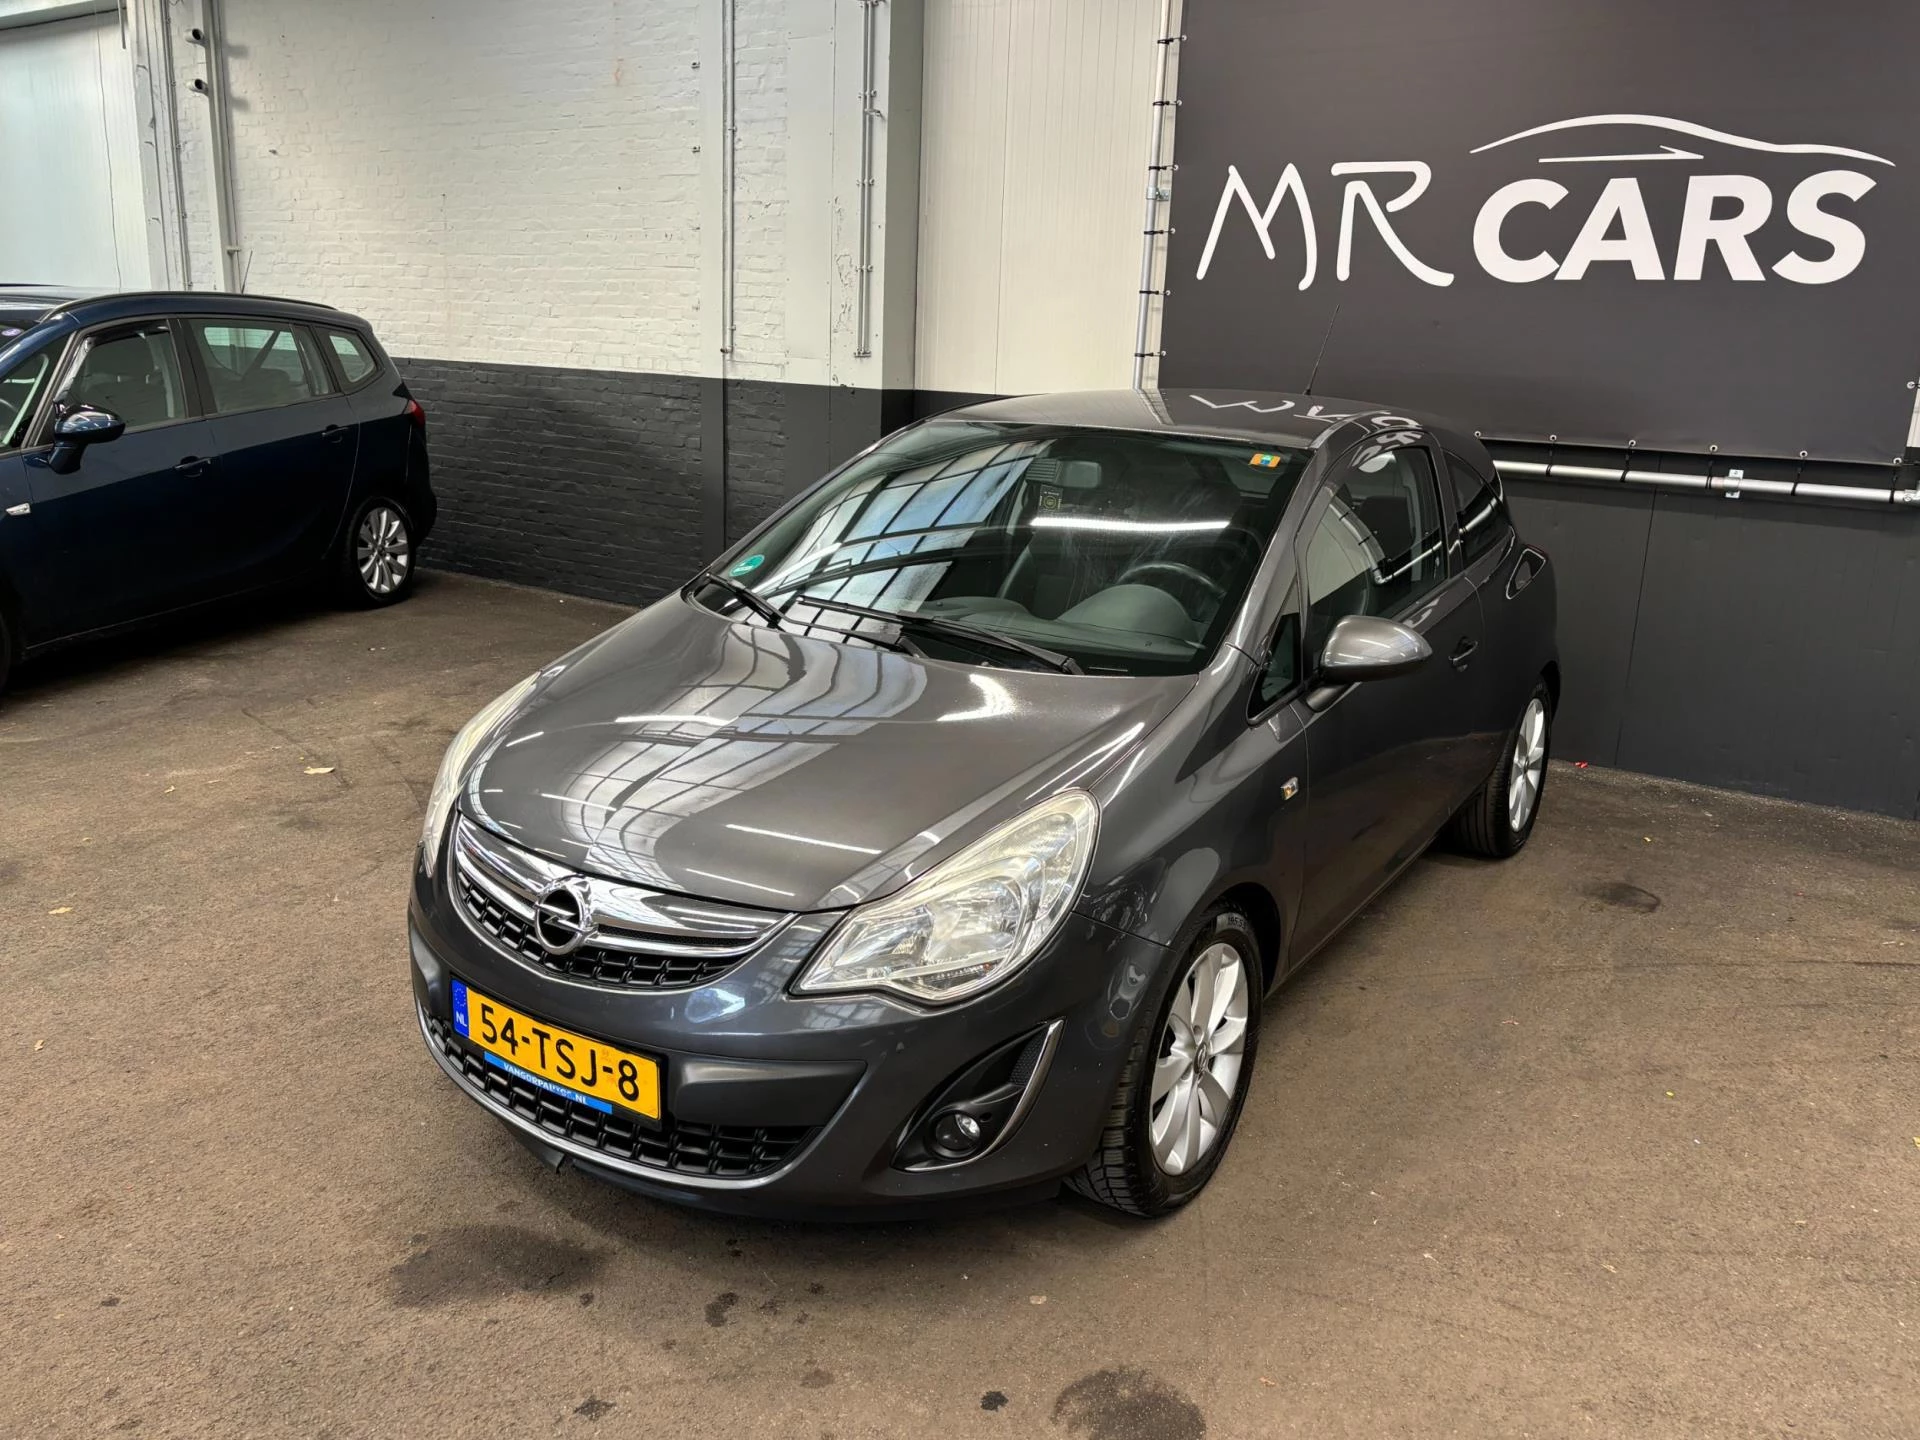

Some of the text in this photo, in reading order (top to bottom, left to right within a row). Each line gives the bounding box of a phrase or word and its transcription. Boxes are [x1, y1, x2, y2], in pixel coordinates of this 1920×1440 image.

[1196, 162, 1877, 291] MR CARS
[455, 1011, 468, 1028] NL
[481, 1003, 640, 1102] 54-TSJ-8
